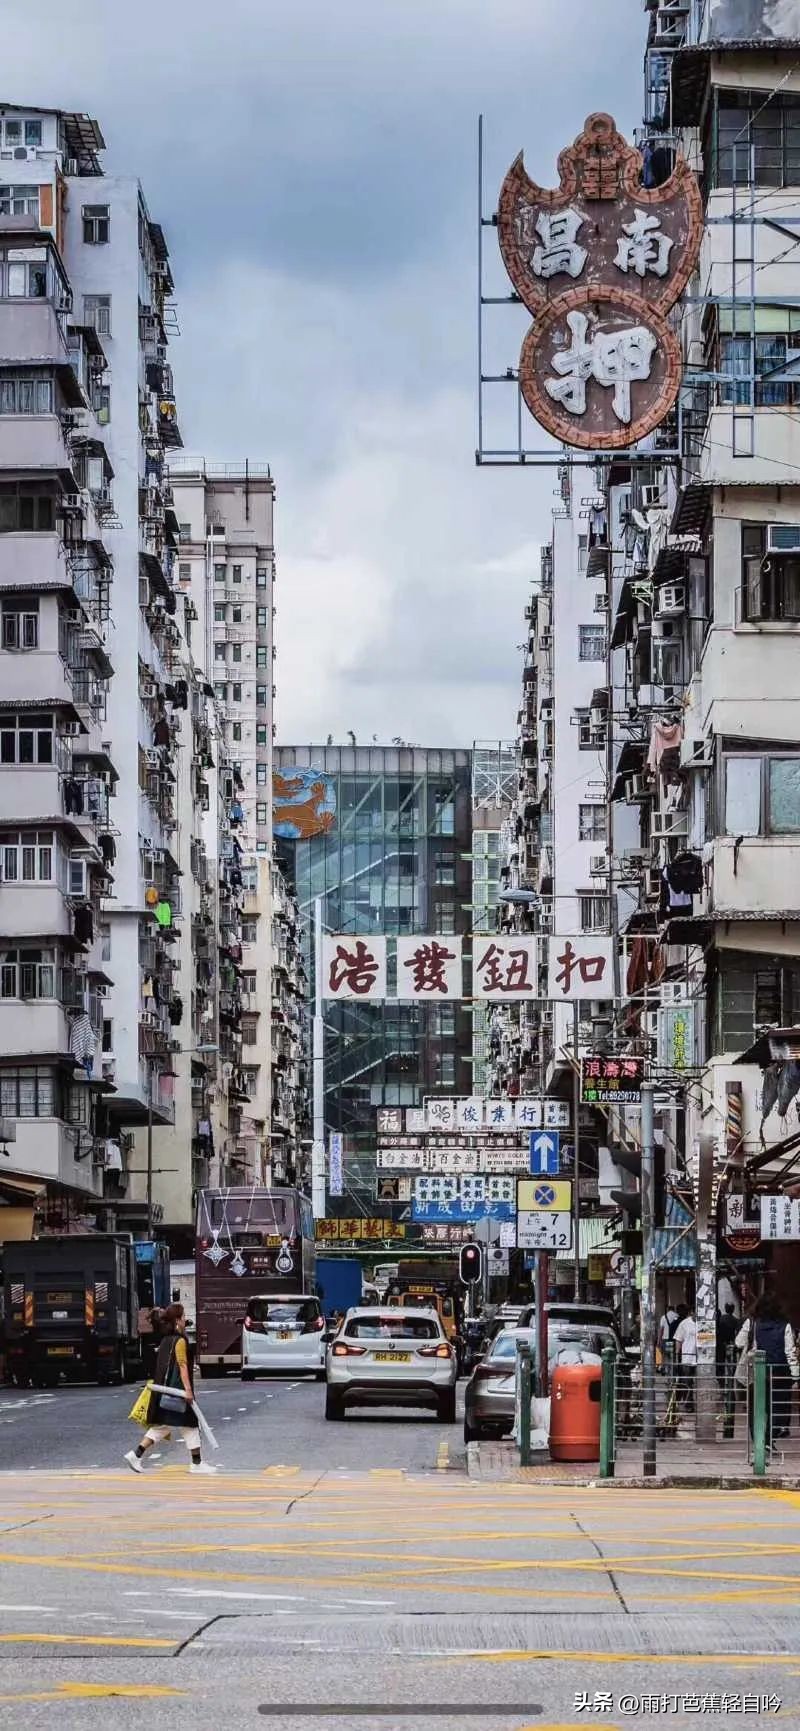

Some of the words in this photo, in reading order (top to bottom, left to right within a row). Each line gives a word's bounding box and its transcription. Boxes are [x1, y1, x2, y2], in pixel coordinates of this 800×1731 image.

[544, 310, 657, 424] 押
[550, 1213, 559, 1225] 7
[550, 1233, 567, 1246] 12
